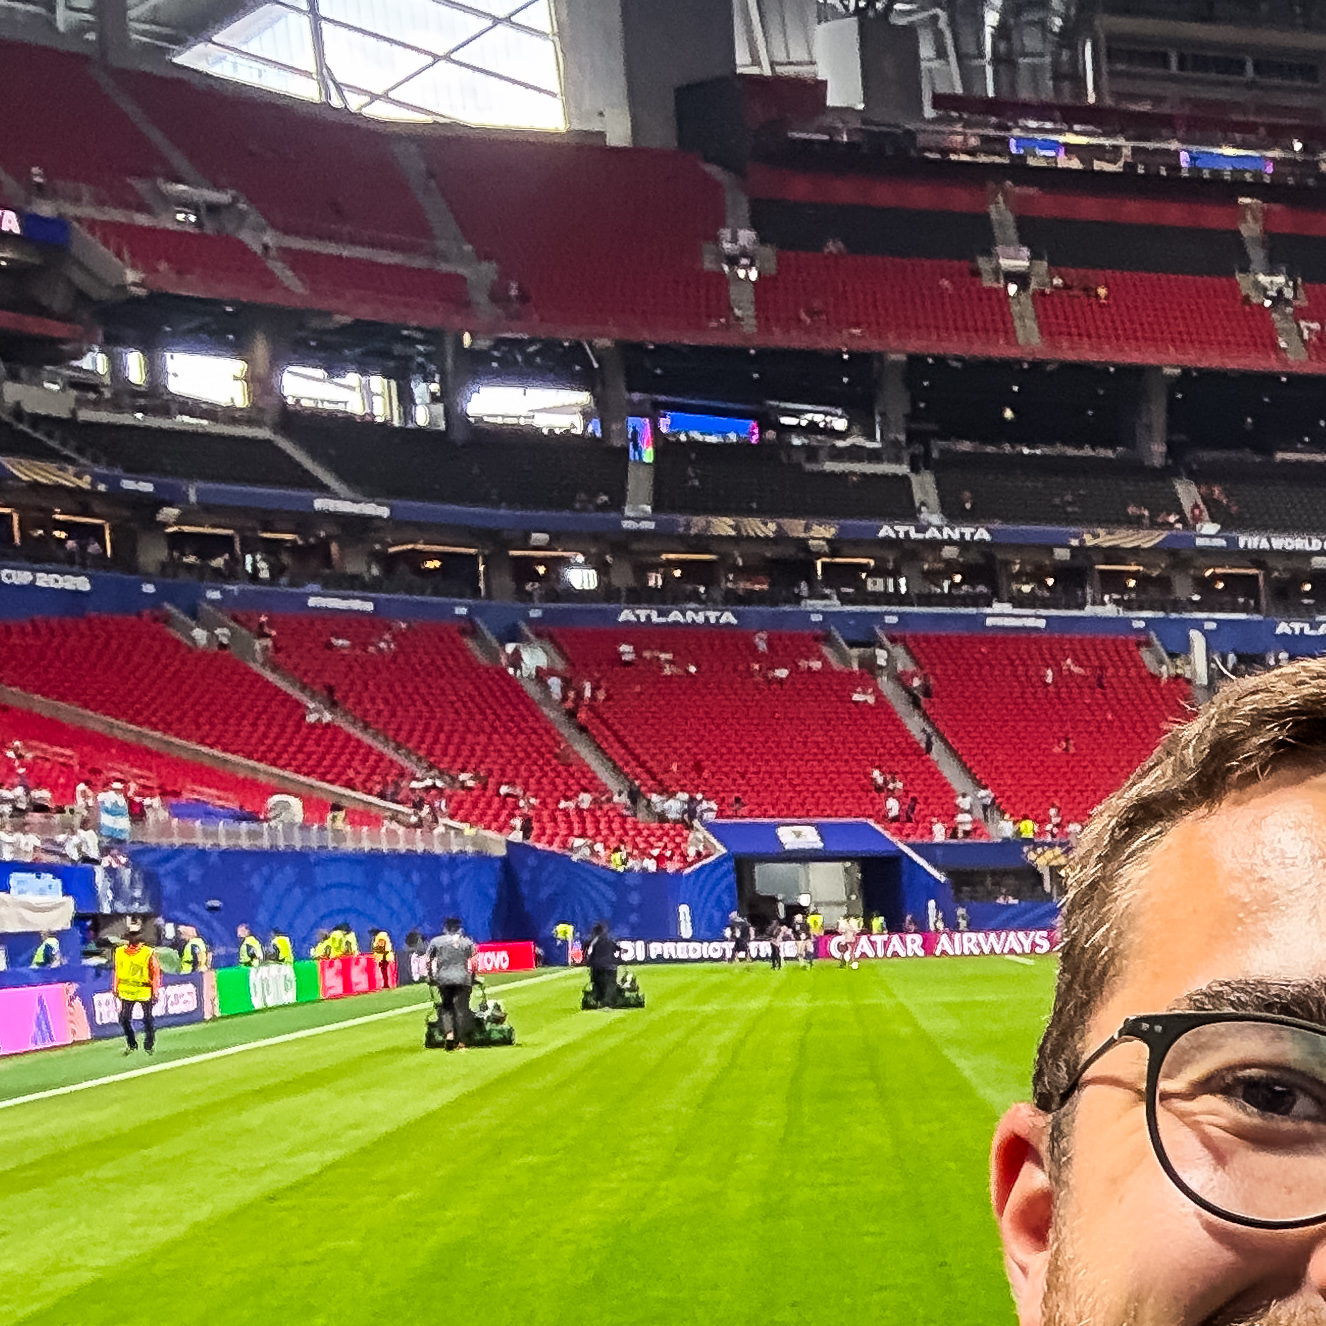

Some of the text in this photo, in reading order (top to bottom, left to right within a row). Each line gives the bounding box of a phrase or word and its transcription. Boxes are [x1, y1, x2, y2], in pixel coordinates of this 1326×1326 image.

[877, 524, 993, 542] ATLANTA
[617, 608, 738, 625] ATLANTA
[933, 930, 1051, 956] AIRWAYS
